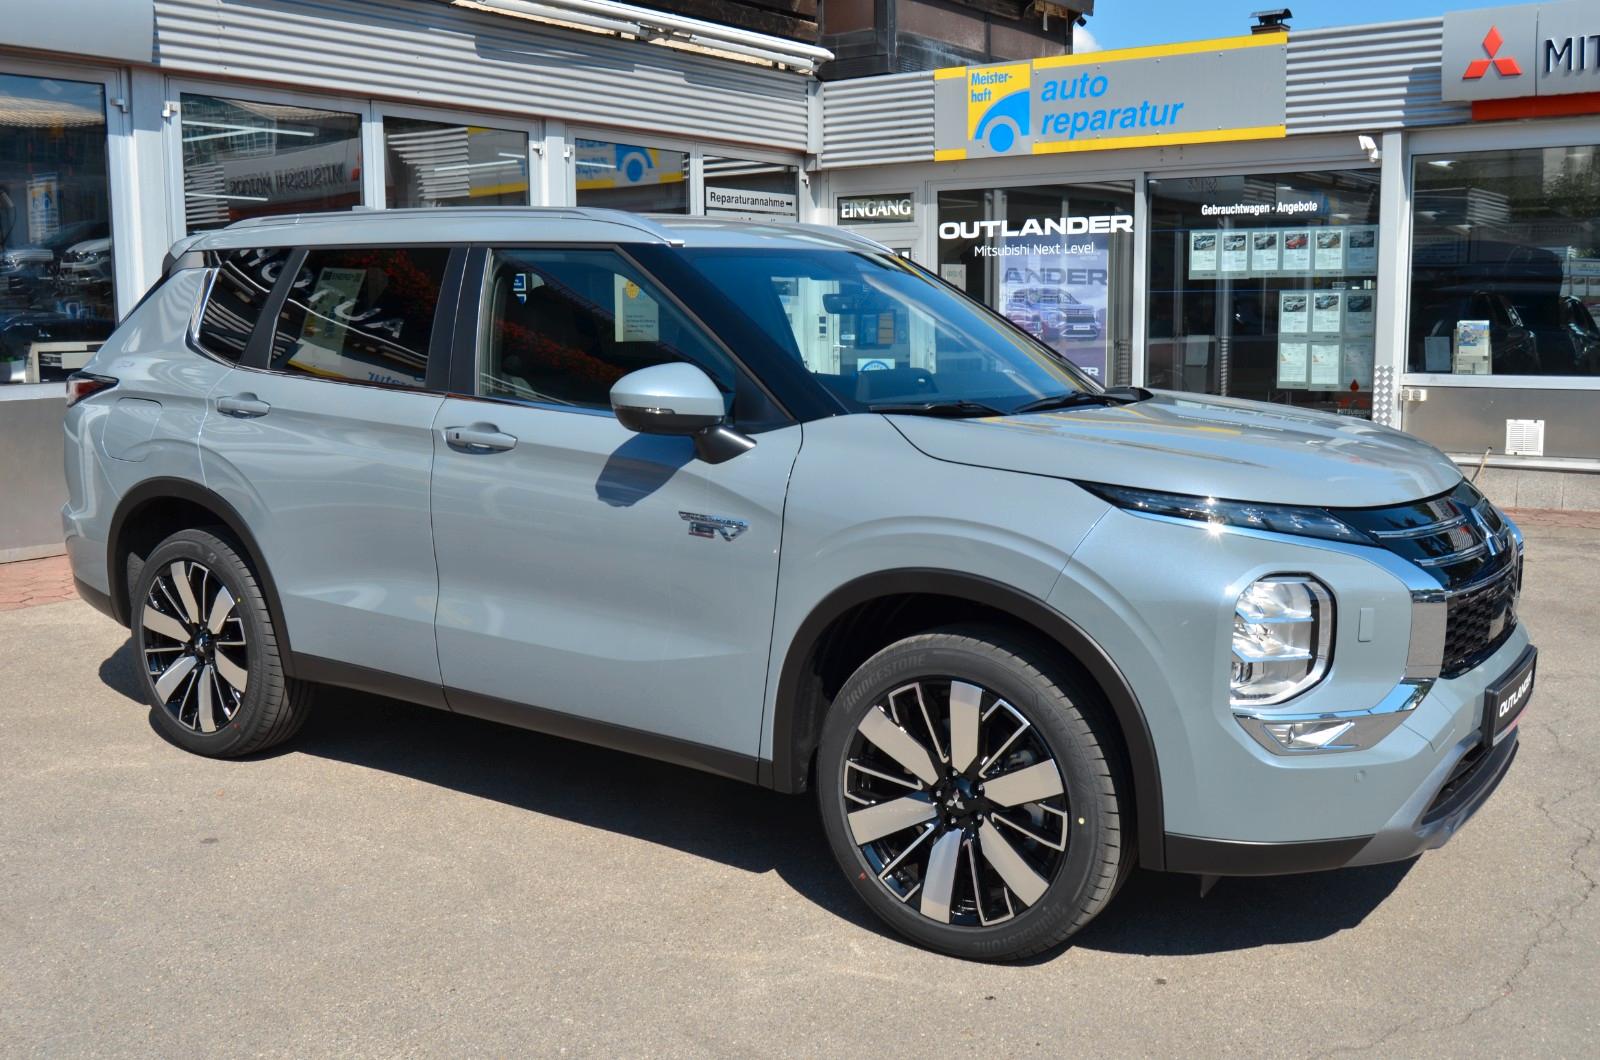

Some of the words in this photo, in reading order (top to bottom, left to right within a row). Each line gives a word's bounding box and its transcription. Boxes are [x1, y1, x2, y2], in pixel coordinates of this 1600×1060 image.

[971, 72, 1013, 86] Meister-
[1041, 72, 1108, 102] auto
[970, 89, 992, 103] haft
[1041, 101, 1184, 139] reparatur
[710, 191, 785, 207] Reparaturannahme
[841, 199, 911, 219] EINGANG
[1201, 203, 1270, 216] Gebrauchtwagen
[1277, 201, 1318, 215] Angebote
[939, 214, 1134, 240] OUTLANDER
[974, 243, 1030, 257] Mitsubishi
[1033, 243, 1061, 255] Next
[1064, 241, 1094, 254] Level
[1499, 669, 1533, 718] OUTLANDER
